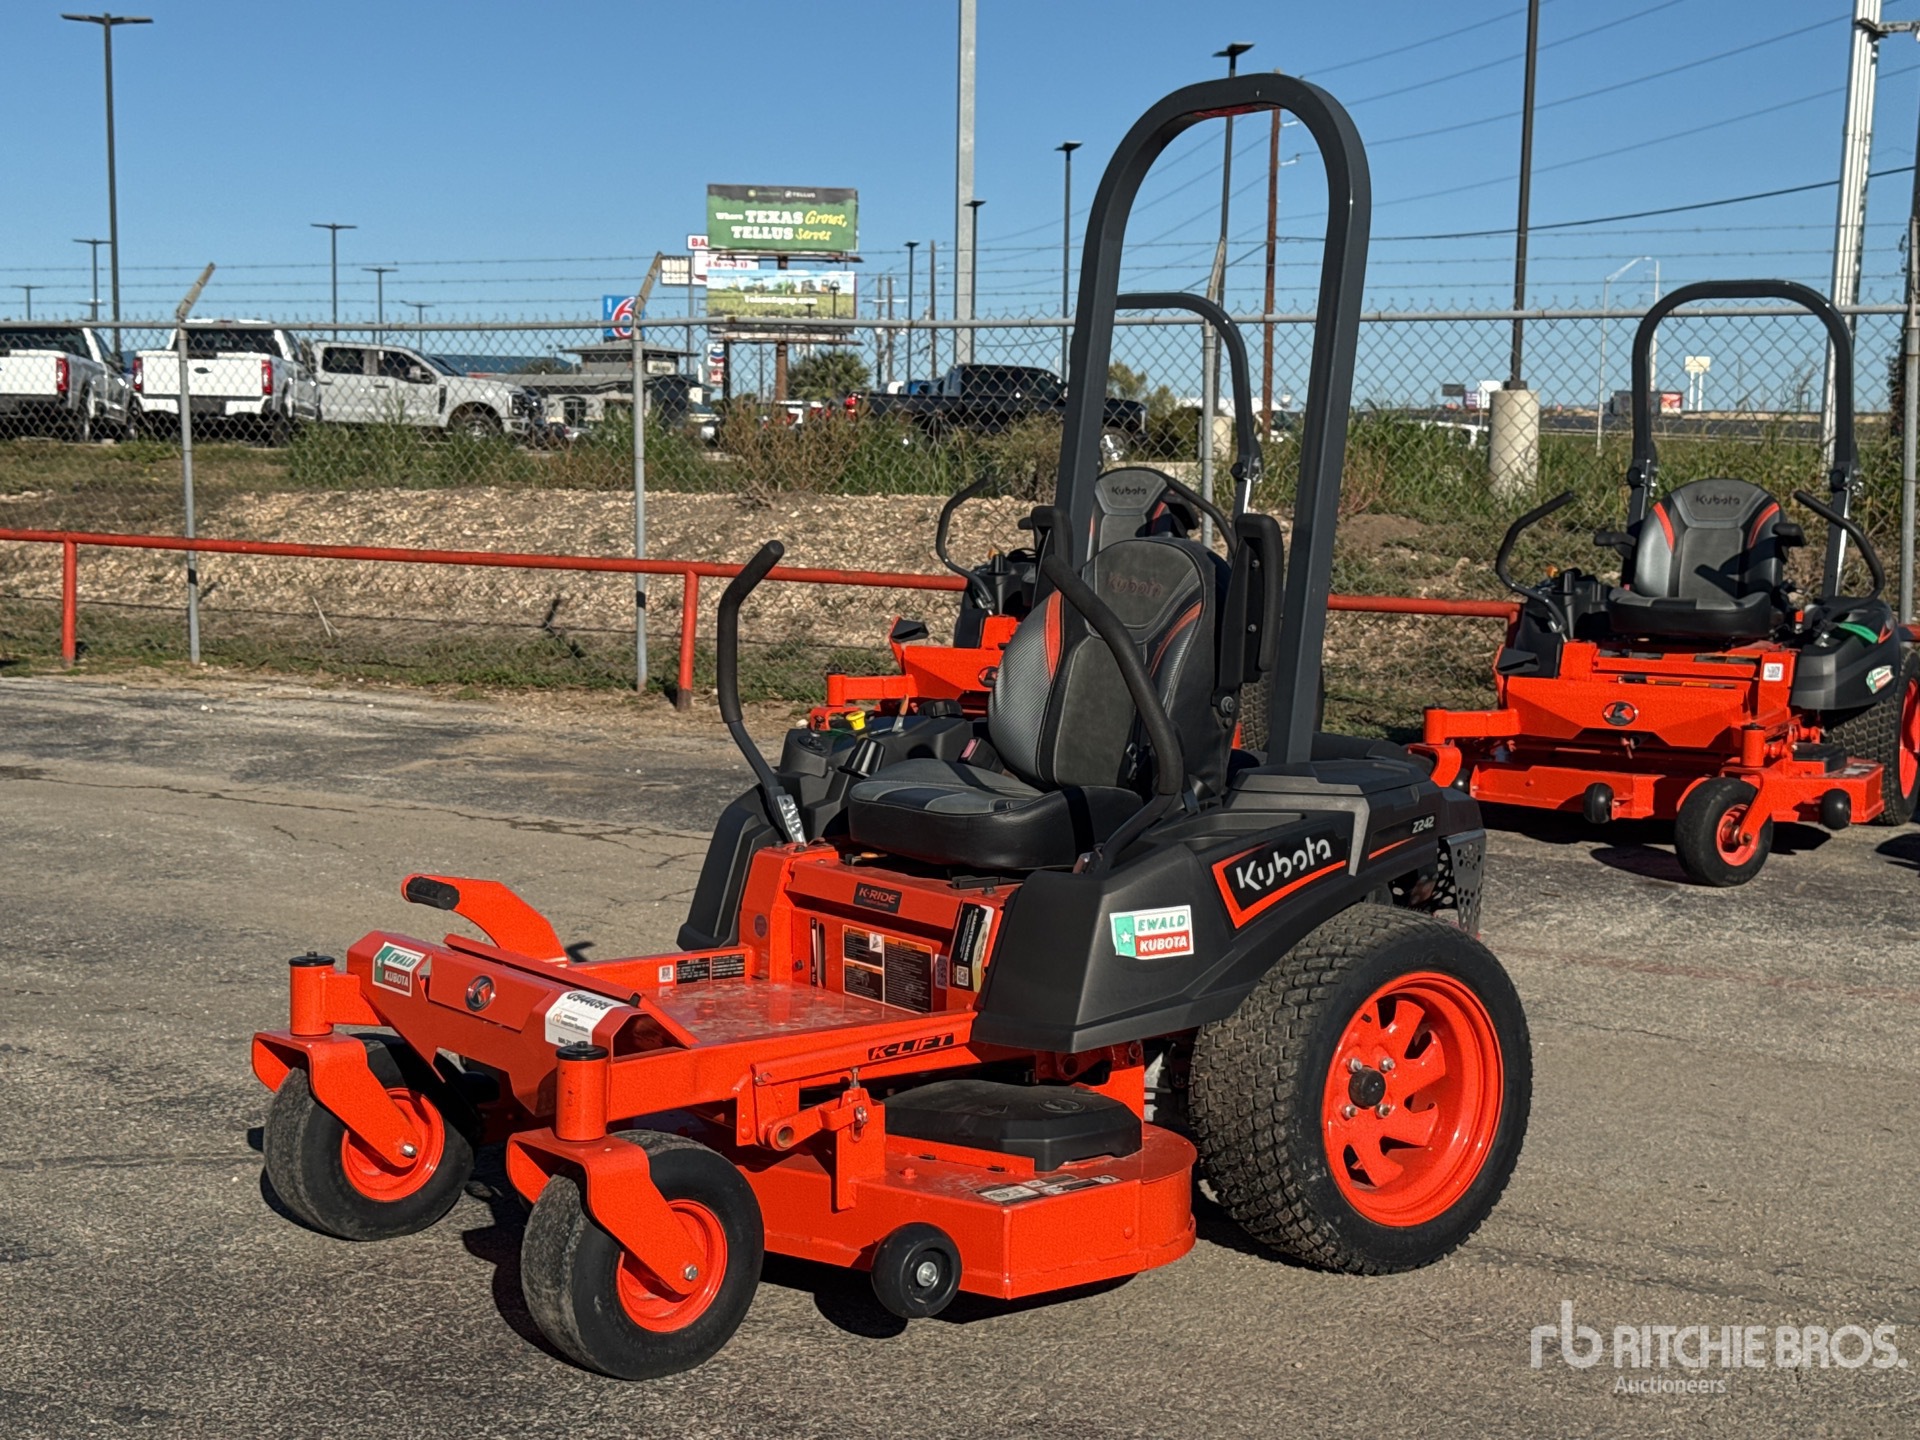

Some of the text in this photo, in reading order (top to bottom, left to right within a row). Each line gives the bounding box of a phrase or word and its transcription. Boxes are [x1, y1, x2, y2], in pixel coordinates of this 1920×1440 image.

[715, 210, 847, 227] Where TEXAS Grows,
[731, 226, 794, 240] TELLUS
[611, 296, 636, 339] 6
[1111, 486, 1147, 496] Kubota
[1695, 495, 1740, 505] Kubota
[1106, 571, 1164, 597] Kubota
[1411, 816, 1435, 834] Z242
[1236, 836, 1332, 891] Kubota
[1138, 915, 1186, 931] EWALD
[1140, 936, 1188, 953] KUBOTA
[387, 952, 417, 967] EWALD
[384, 969, 409, 987] KUBOTA
[871, 1033, 952, 1059] K-LIFT
